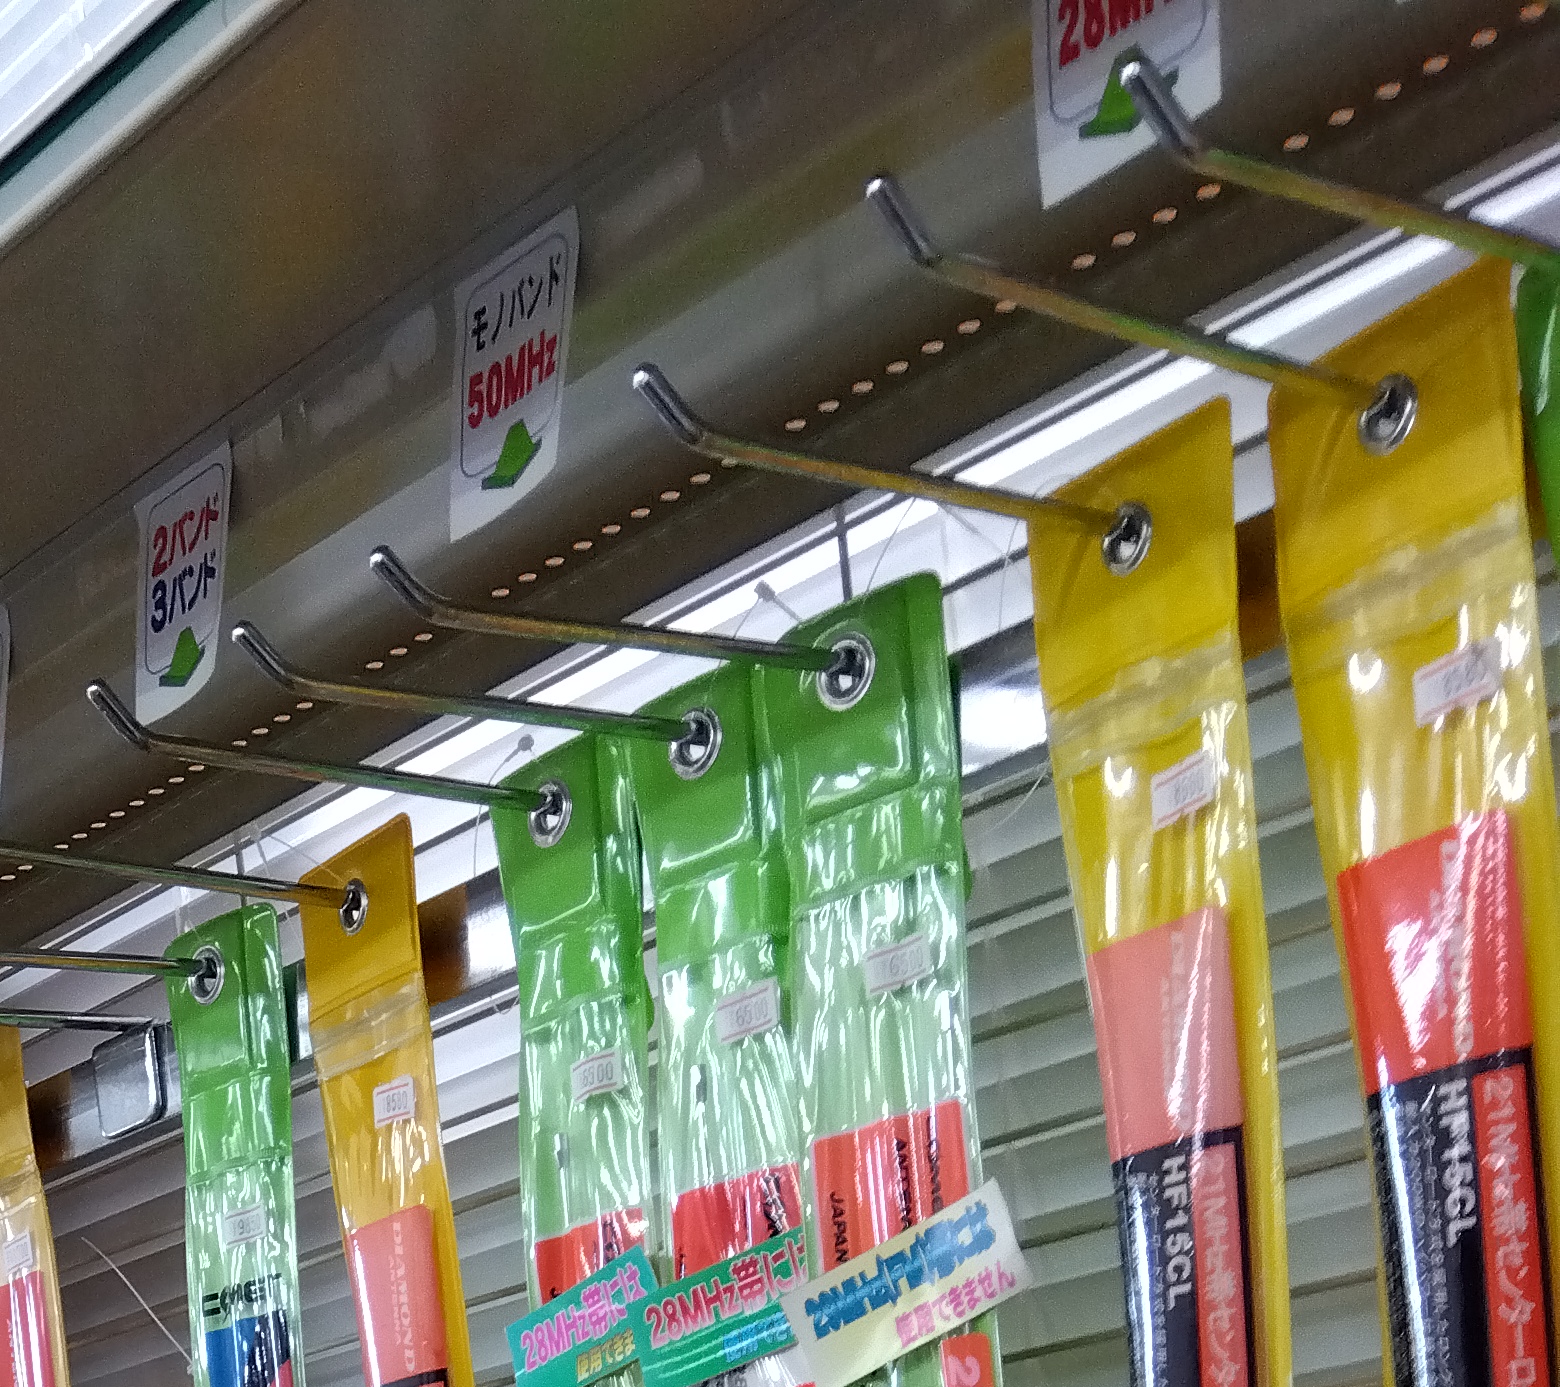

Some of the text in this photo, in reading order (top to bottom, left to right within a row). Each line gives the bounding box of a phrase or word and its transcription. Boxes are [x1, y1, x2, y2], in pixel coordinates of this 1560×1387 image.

[471, 253, 561, 352] モノバンド
[467, 328, 559, 429] 50MHz
[152, 492, 220, 578] 2バンド
[151, 549, 218, 634] 3バンド
[1437, 1077, 1479, 1249] HF15CL
[1159, 1153, 1194, 1311] HF15CL
[387, 1255, 404, 1347] ANTENNA
[391, 1222, 417, 1372] DIAMOND
[520, 1262, 648, 1374] 28MHz帯には
[894, 1260, 1017, 1350] 使用できません
